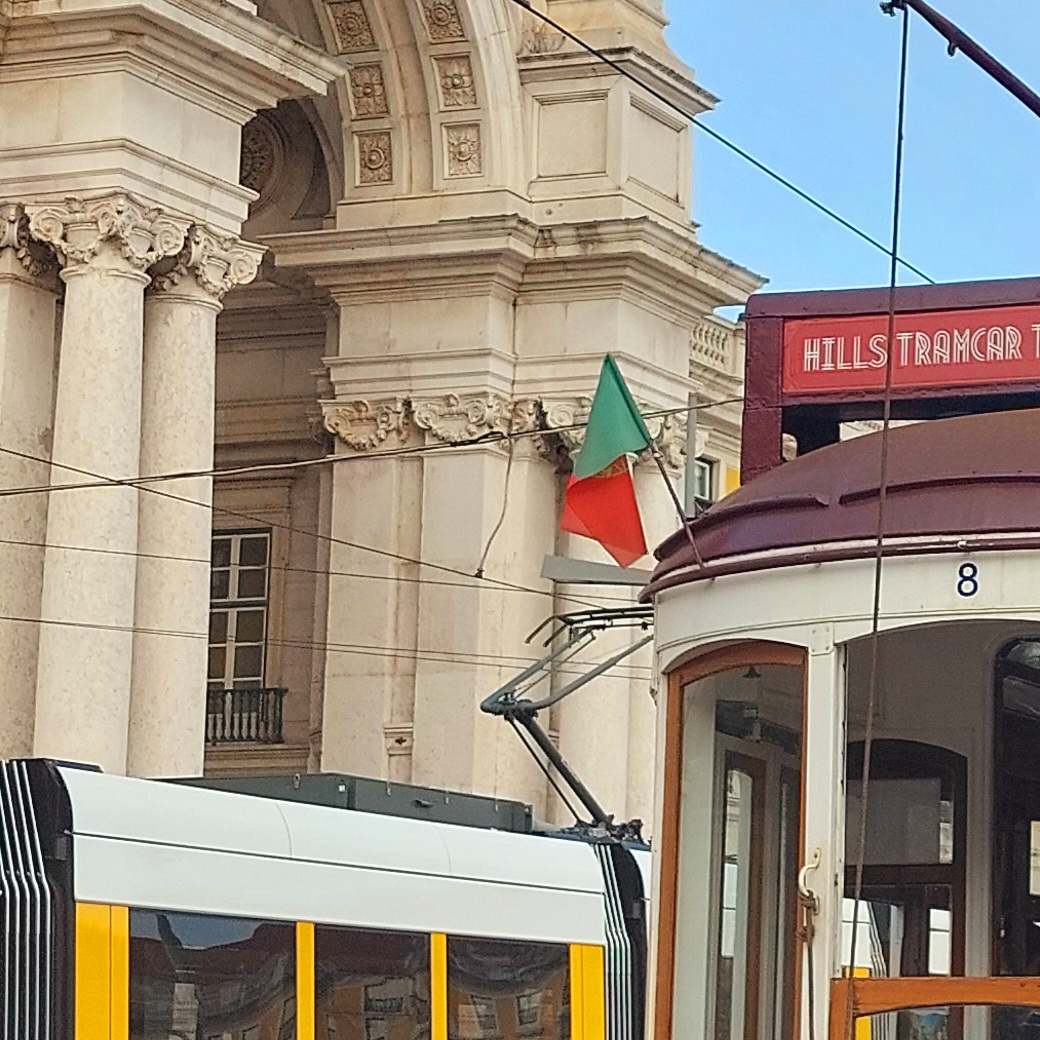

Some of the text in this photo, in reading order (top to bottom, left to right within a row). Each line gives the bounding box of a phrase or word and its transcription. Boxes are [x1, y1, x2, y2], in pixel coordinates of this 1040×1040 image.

[804, 333, 888, 372] HILLS
[896, 325, 1022, 366] TRAMCAR
[956, 562, 979, 597] 8
